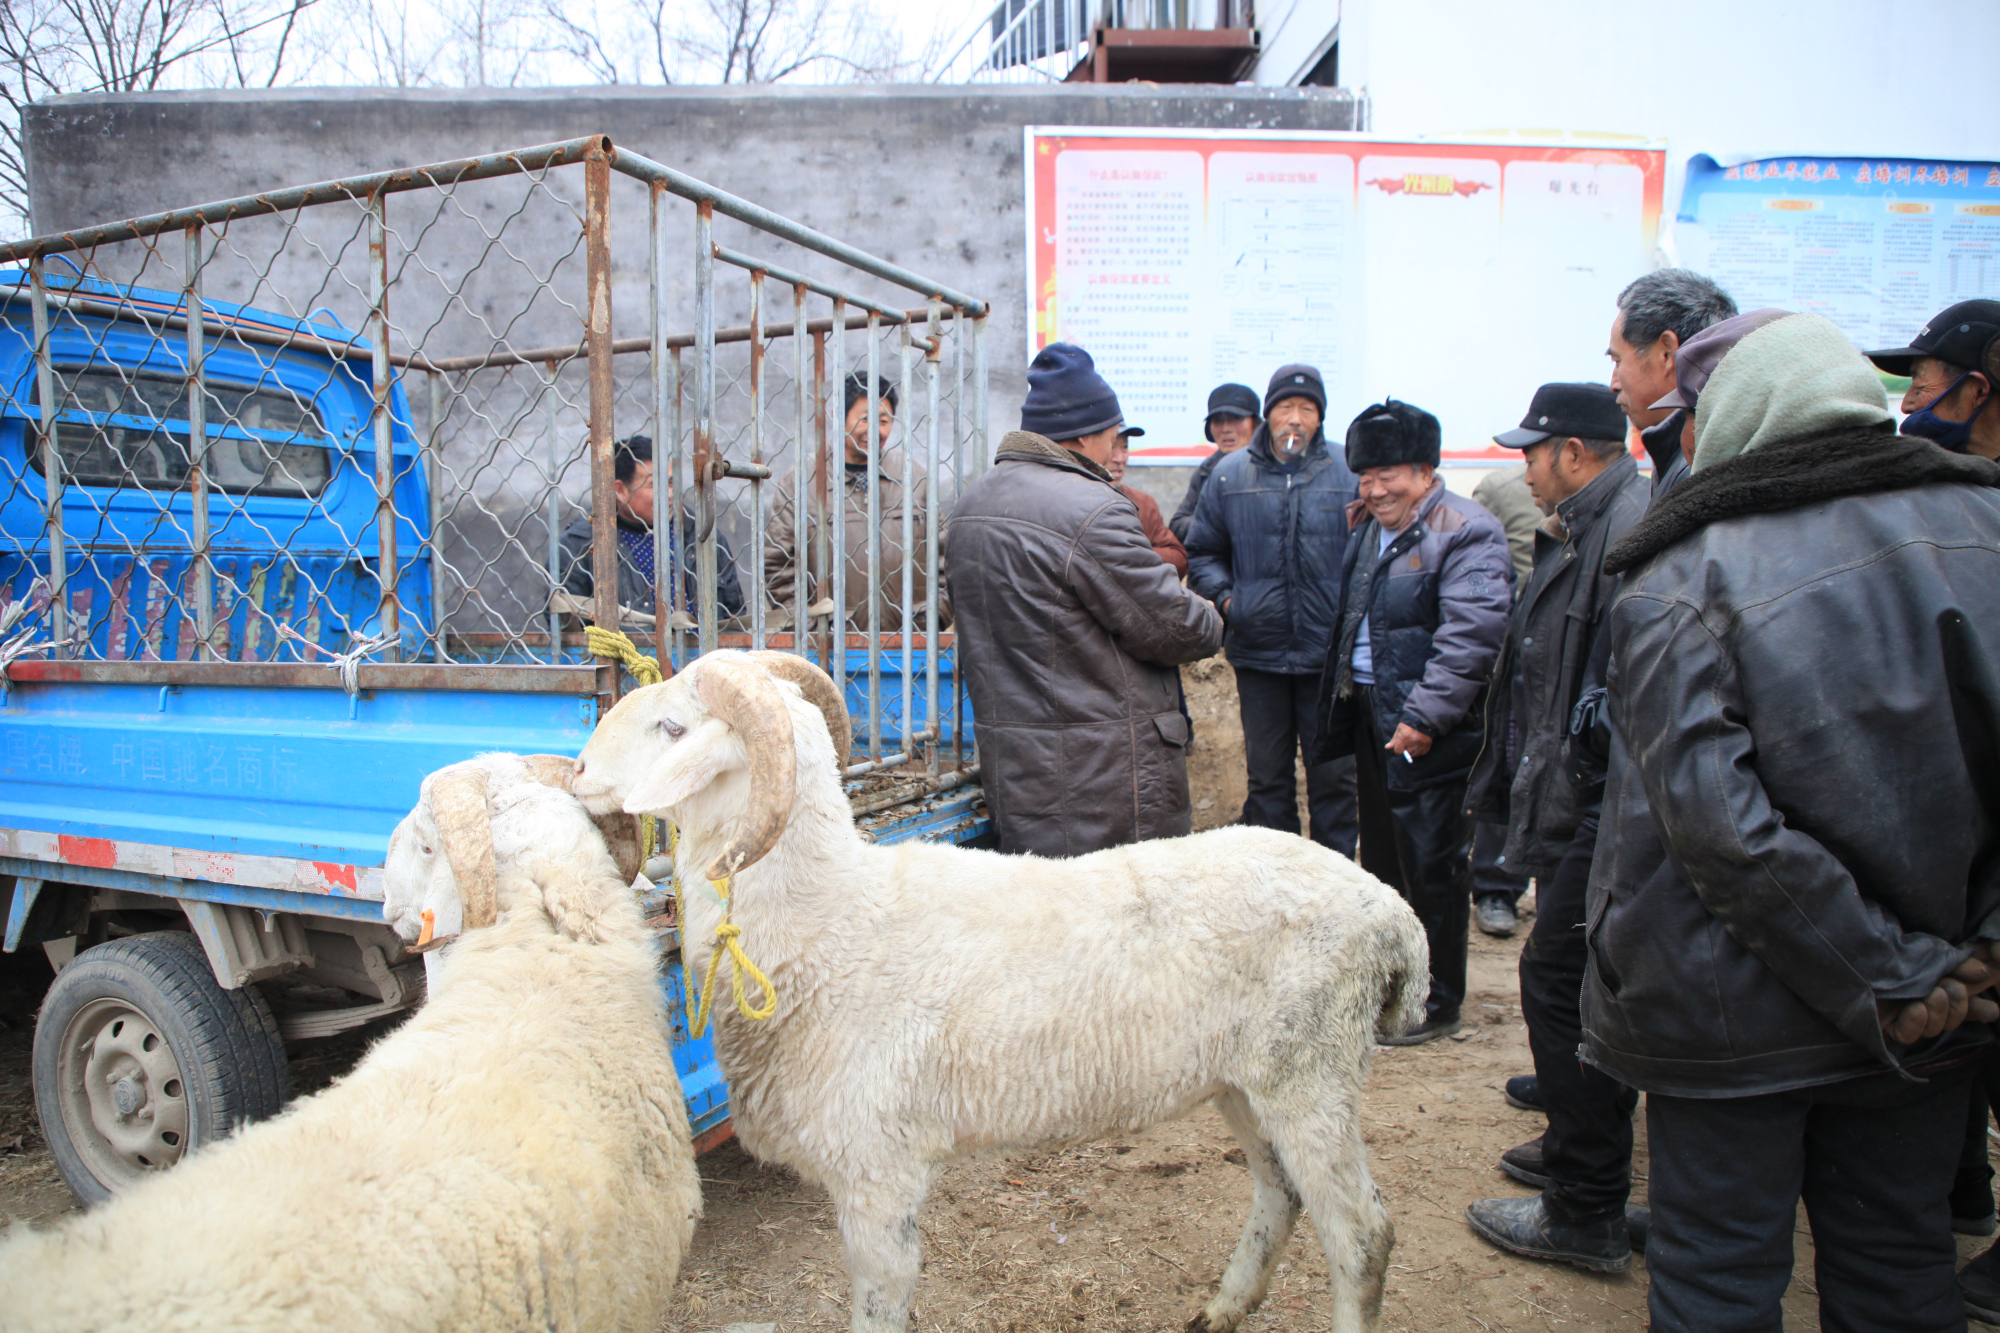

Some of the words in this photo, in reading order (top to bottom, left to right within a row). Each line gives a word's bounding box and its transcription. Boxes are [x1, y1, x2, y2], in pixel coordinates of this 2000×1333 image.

[1403, 173, 1455, 195] 光荣榜
[1855, 162, 1969, 187] 应培训尽培训
[1549, 179, 1600, 196] 曝光台
[112, 735, 299, 792] 中国驰名商标
